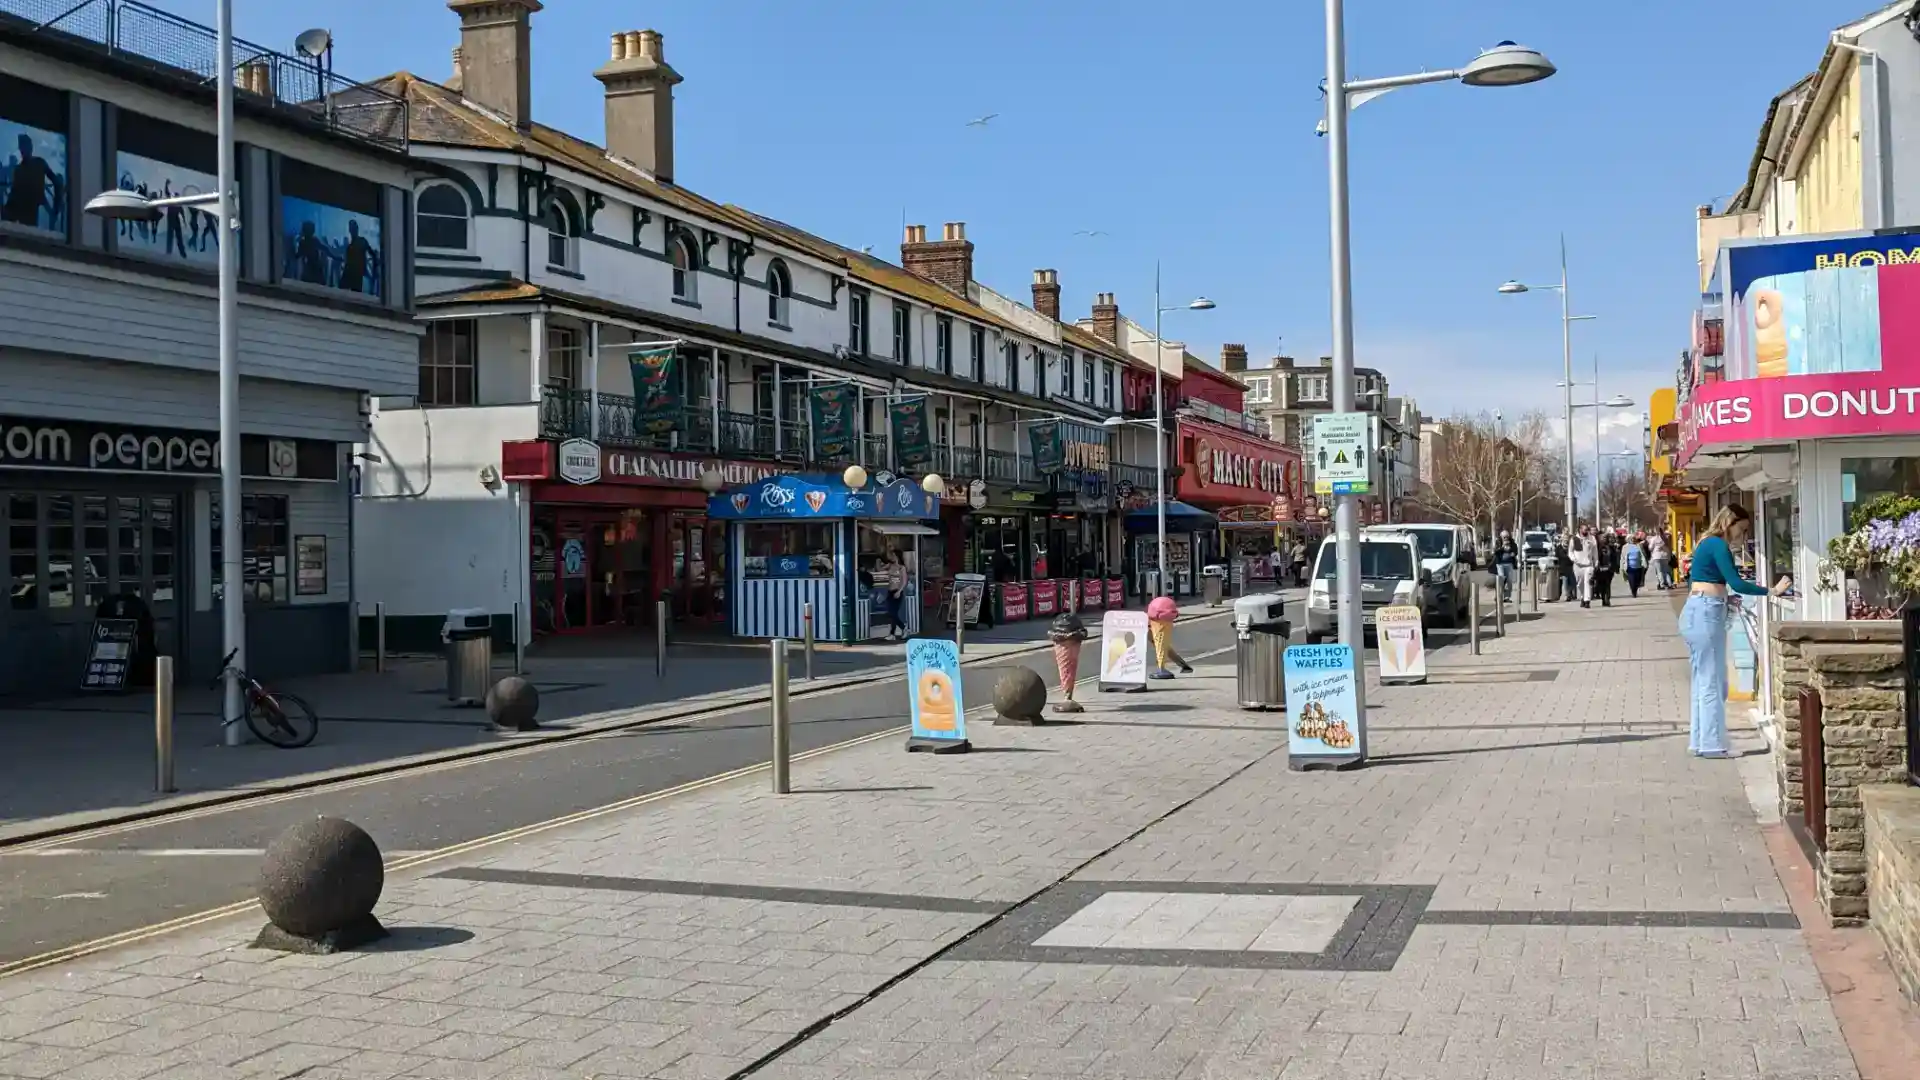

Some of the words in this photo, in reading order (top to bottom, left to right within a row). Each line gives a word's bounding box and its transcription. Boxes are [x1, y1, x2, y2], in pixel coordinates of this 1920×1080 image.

[1213, 449, 1255, 488] MAGIC
[1260, 459, 1284, 493] CITY
[909, 643, 928, 666] FRESH
[928, 641, 958, 668] DONUTS
[1287, 648, 1322, 658] FRESH
[1325, 647, 1349, 657] HOT
[1294, 658, 1344, 669] WAFFLES
[1292, 680, 1310, 694] with
[1310, 680, 1322, 689] ice
[1323, 673, 1349, 686] cream
[1312, 685, 1345, 702] toppings
